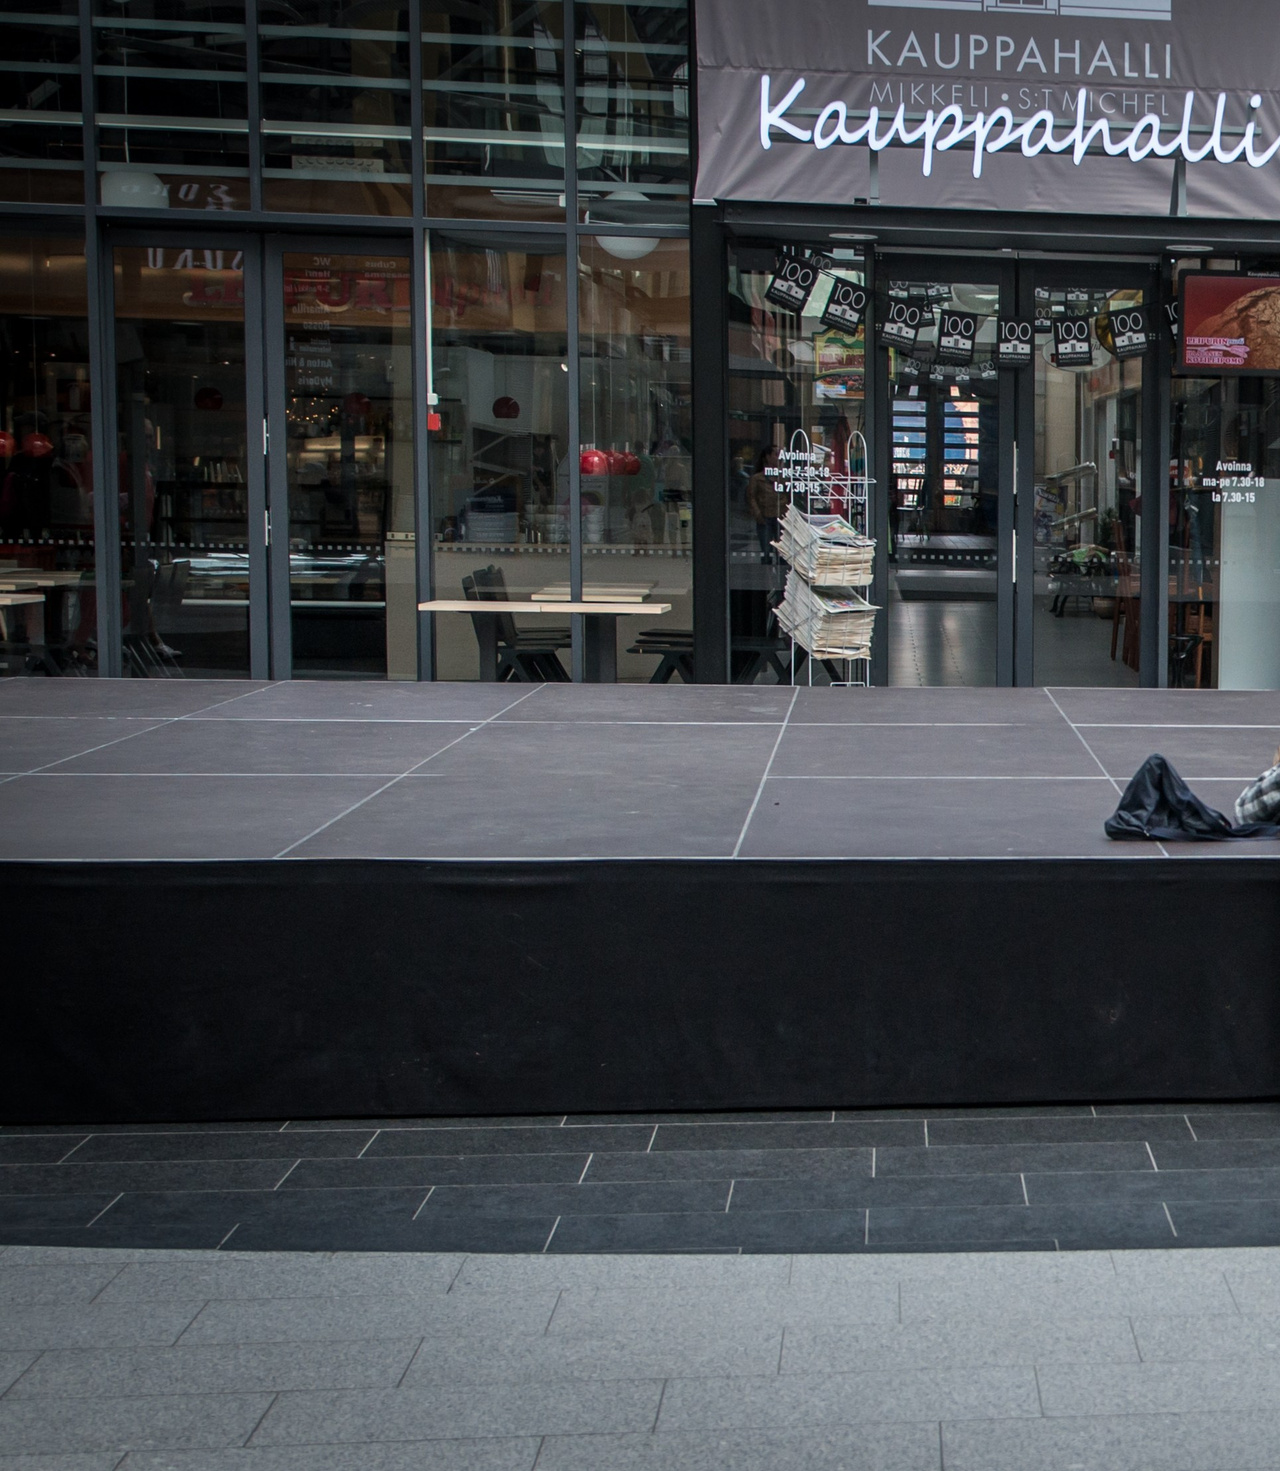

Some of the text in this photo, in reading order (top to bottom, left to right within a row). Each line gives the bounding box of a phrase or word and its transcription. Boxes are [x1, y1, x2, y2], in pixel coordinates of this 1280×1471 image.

[867, 30, 1172, 80] KAUPPAHALLI
[869, 81, 988, 109] MIKKELI
[1062, 88, 1170, 117] MICHEL
[781, 259, 813, 286] 100
[834, 283, 866, 309] 100
[889, 302, 920, 325] 100
[1111, 312, 1143, 334] 100
[943, 315, 975, 336] 100
[1001, 321, 1032, 340] 100
[1056, 321, 1089, 340] 100
[778, 450, 816, 461] Avoinna
[1216, 461, 1252, 472] Avoinna
[774, 481, 784, 493] la
[1203, 477, 1265, 488] ma-pe 7.30-18
[1212, 492, 1256, 503] la 7.30-15
